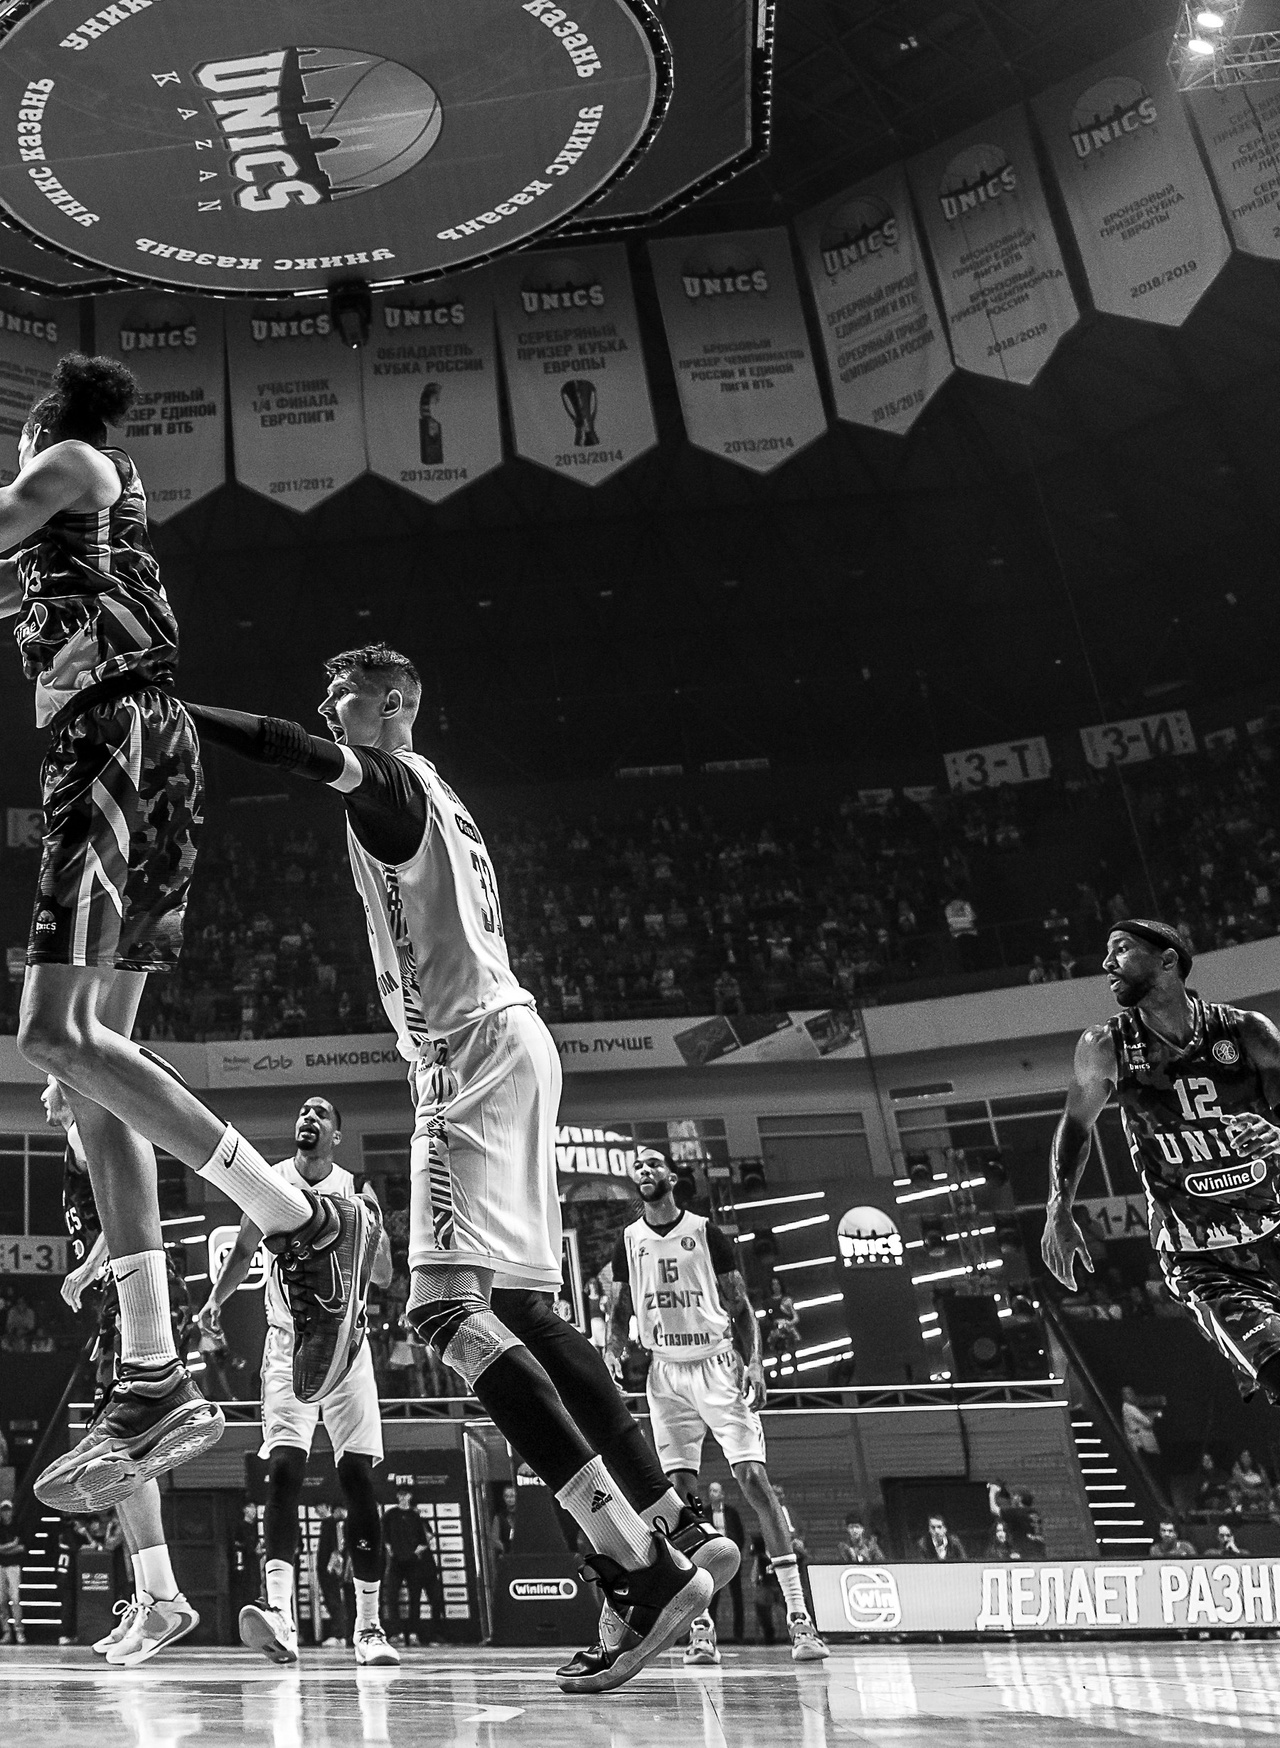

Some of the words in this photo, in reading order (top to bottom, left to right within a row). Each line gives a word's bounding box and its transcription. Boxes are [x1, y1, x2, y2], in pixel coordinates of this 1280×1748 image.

[198, 50, 320, 212] UNICS
[1072, 98, 1157, 158] UNICS
[940, 165, 1016, 220] UNICS
[822, 219, 898, 276] UNICS
[682, 270, 769, 298] UNICS
[1130, 259, 1198, 299] 2018/2019
[521, 284, 605, 313] UNICS
[251, 313, 331, 341] UNICS
[384, 303, 466, 329] UNICS
[120, 326, 198, 351] UNICS
[518, 323, 619, 346] СЕРЕБРЯНЫЙ
[376, 344, 474, 360] ОБЛАДАТЕЛЬ
[517, 344, 573, 361] ПРИЗЕР
[578, 338, 629, 356] КУБКА
[373, 360, 422, 375] КУБКА
[426, 358, 485, 374] РОССИИ
[543, 357, 606, 375] ЕВРОПЫ
[137, 388, 205, 407] ЕБРЯНЫЙ
[256, 378, 331, 397] УЧАСТНИК
[160, 402, 217, 420] ЕДИНОЙ
[251, 400, 272, 414] 1/4
[276, 392, 339, 410] ФИНАЛА
[125, 423, 163, 438] ЛИГИ
[166, 421, 194, 435] ВТБ
[260, 409, 336, 428] ЕВРОЛИГИ
[724, 436, 794, 454] 2013/2014
[555, 449, 624, 467] 2013/2014
[269, 476, 335, 494] 2011/2012
[401, 468, 468, 482] 2013/2014
[305, 1050, 401, 1067] БАНКОВСКИ
[592, 1036, 654, 1051] ЛУЧШЕ
[1172, 1076, 1221, 1121] 12
[1192, 1169, 1251, 1193] Winline
[658, 1257, 679, 1284] 15
[644, 1290, 704, 1311] ZENIT
[515, 1584, 558, 1595] Winline
[976, 1566, 1144, 1631] ДЕЛАЕТ
